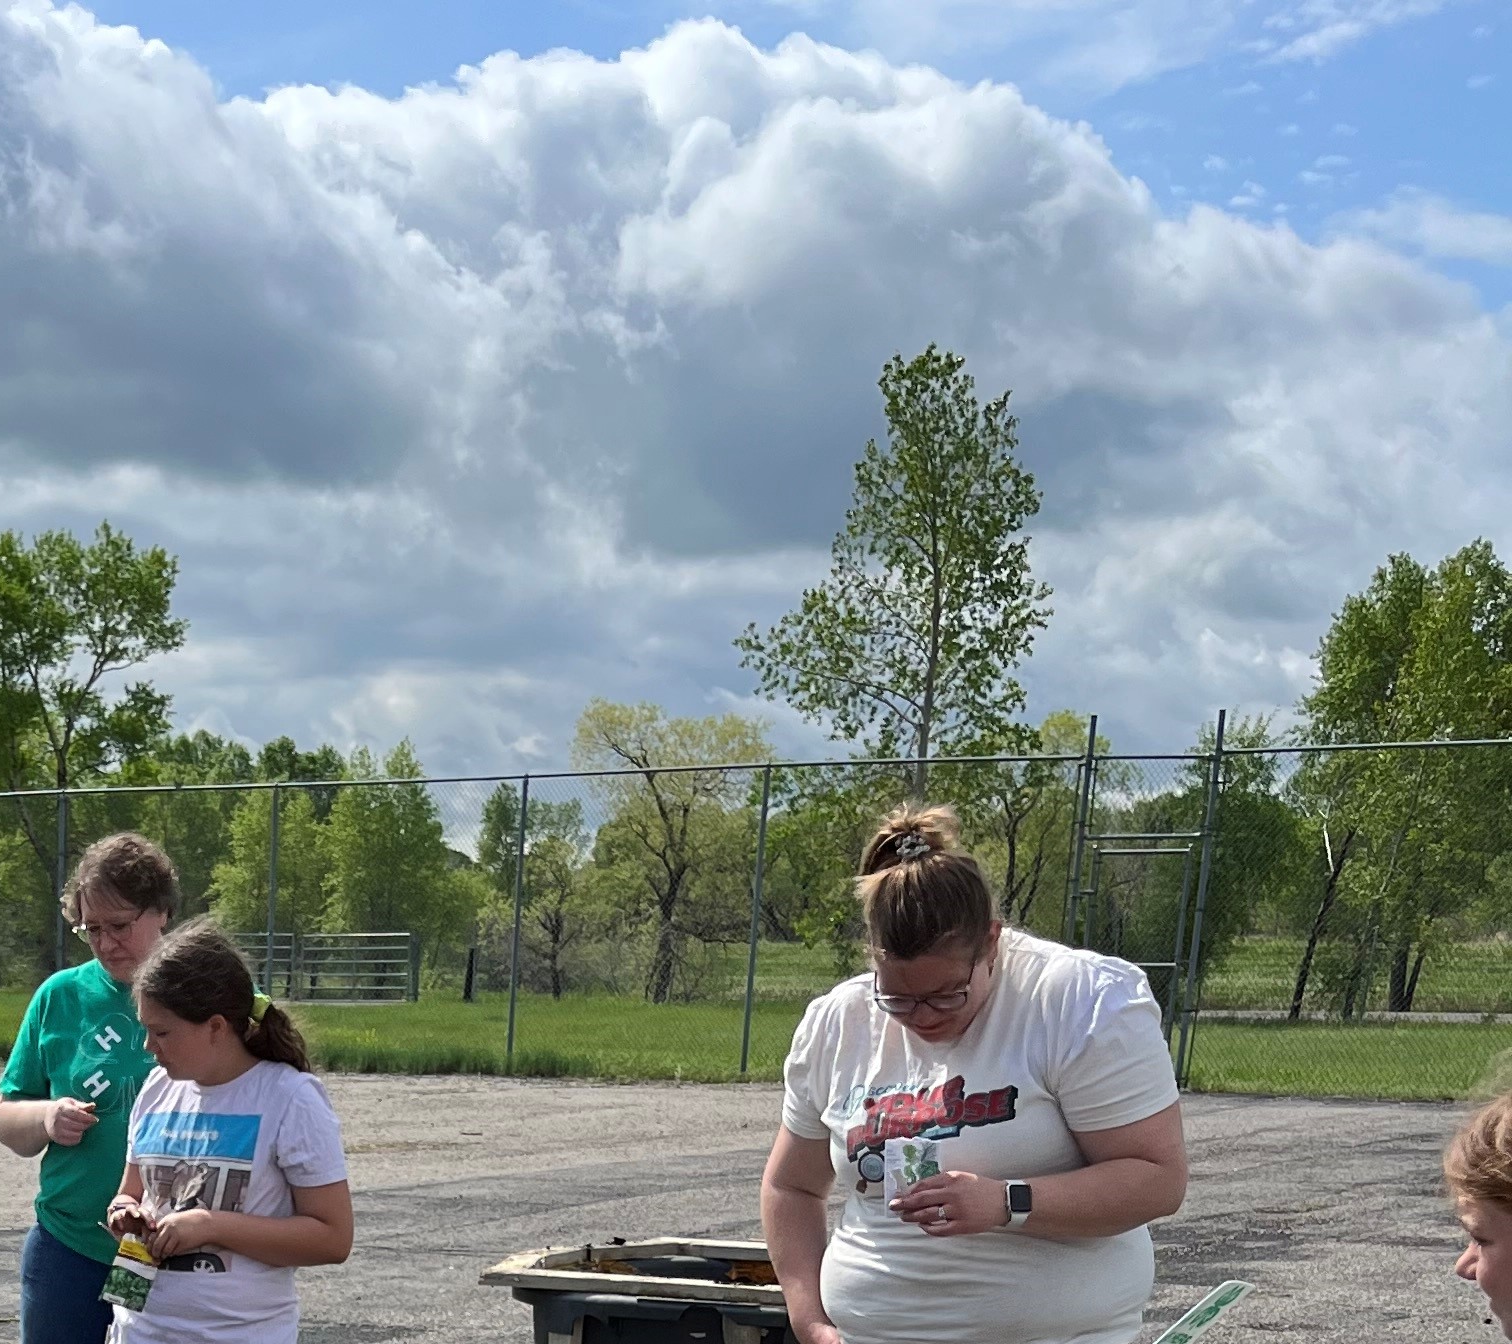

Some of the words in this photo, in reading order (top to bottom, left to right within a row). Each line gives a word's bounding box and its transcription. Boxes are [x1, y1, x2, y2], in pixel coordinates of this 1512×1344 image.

[94, 1025, 122, 1051] H
[82, 1070, 111, 1099] H
[847, 1085, 1018, 1162] PURPOSE
